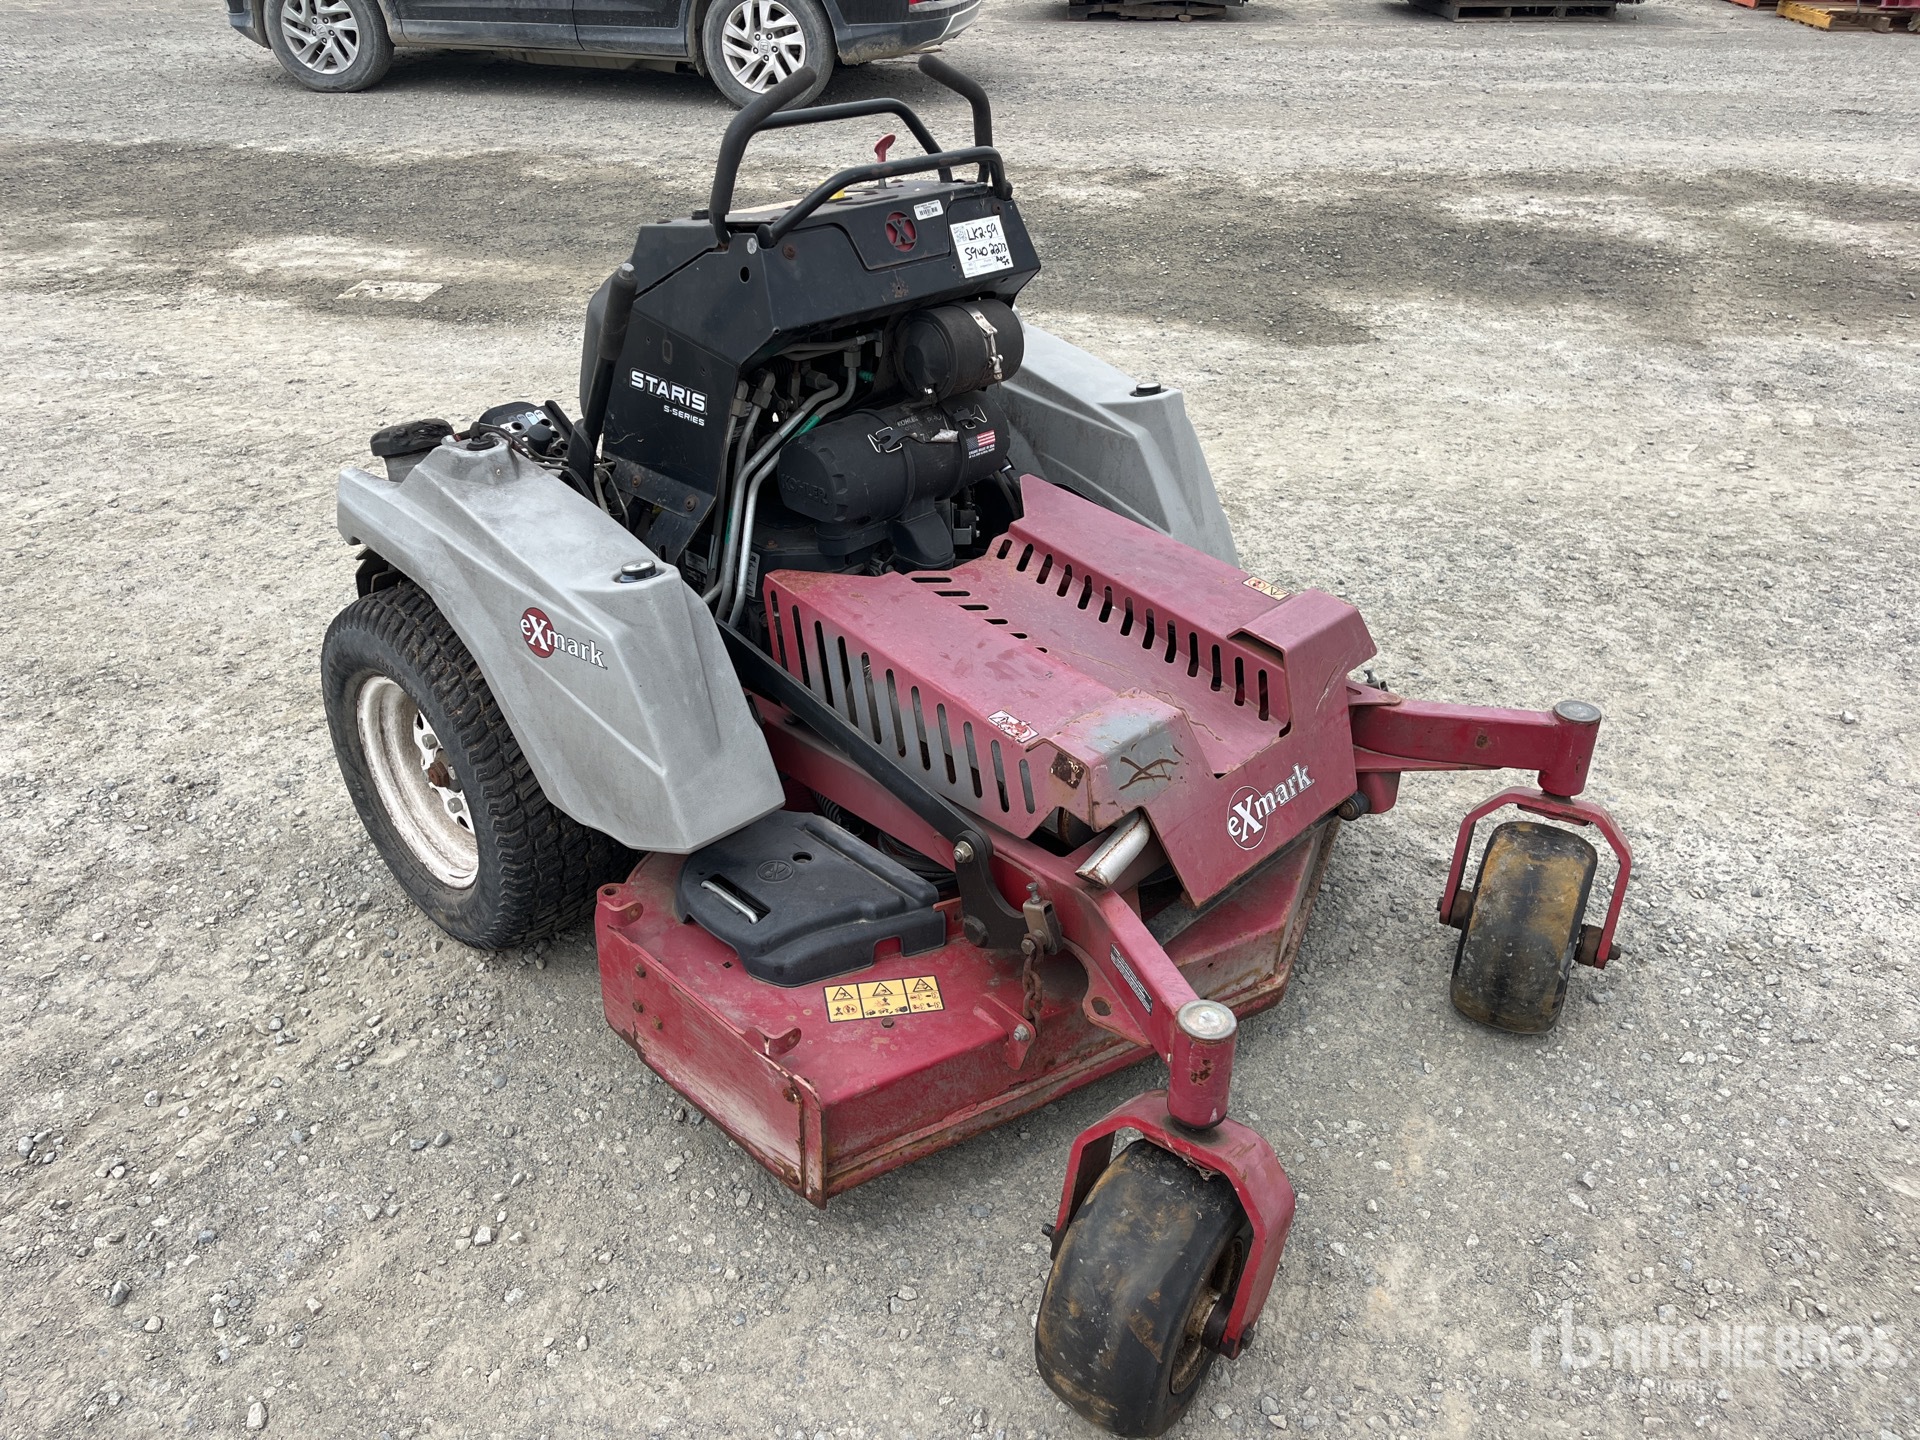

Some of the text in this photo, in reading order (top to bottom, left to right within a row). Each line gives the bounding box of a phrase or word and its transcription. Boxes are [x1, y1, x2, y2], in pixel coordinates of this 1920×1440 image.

[631, 370, 706, 412] STARIS
[663, 404, 705, 427] S-SERIES
[779, 473, 829, 506] KOHLER
[520, 613, 606, 668] eXmark
[1228, 763, 1312, 843] eXmark
